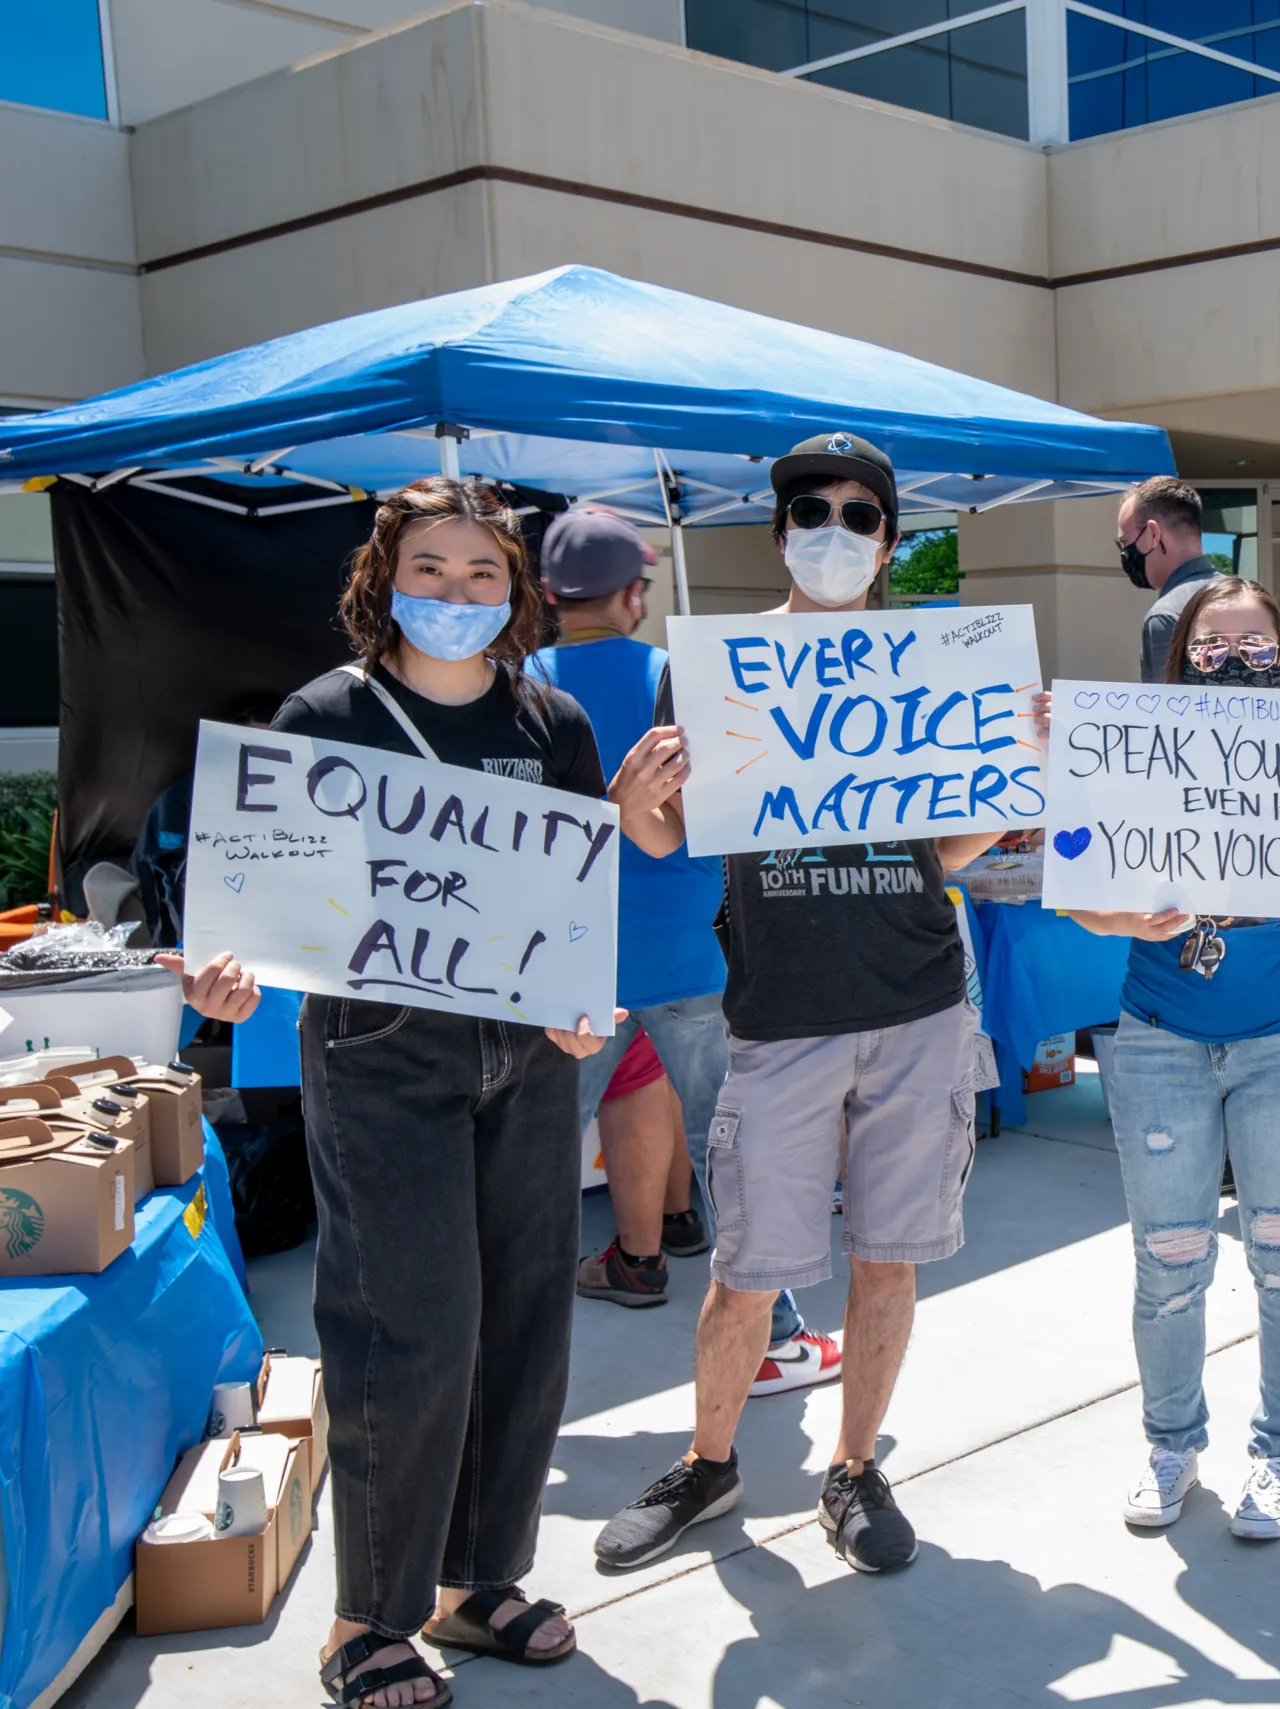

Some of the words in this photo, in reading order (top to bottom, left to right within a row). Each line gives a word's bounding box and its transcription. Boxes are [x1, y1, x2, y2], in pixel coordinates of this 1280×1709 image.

[940, 612, 1004, 646] #ACTIBLIZZ
[961, 622, 1002, 648] WALKOUT
[722, 629, 917, 693] EVERY
[768, 683, 1018, 761] VOICE
[1068, 722, 1198, 781] SPEAK
[236, 743, 615, 883] EQUALITY
[752, 764, 1045, 837] MATTERS
[1183, 786, 1260, 817] EVEN
[225, 846, 334, 860] WALKOUT
[1097, 820, 1206, 882] YOUR
[366, 859, 480, 914] FOR
[759, 868, 805, 890] 10TH
[809, 866, 871, 896] FUN
[874, 866, 924, 894] RUN
[763, 888, 806, 898] ANNIVERSARY
[347, 918, 547, 1004] ALL!
